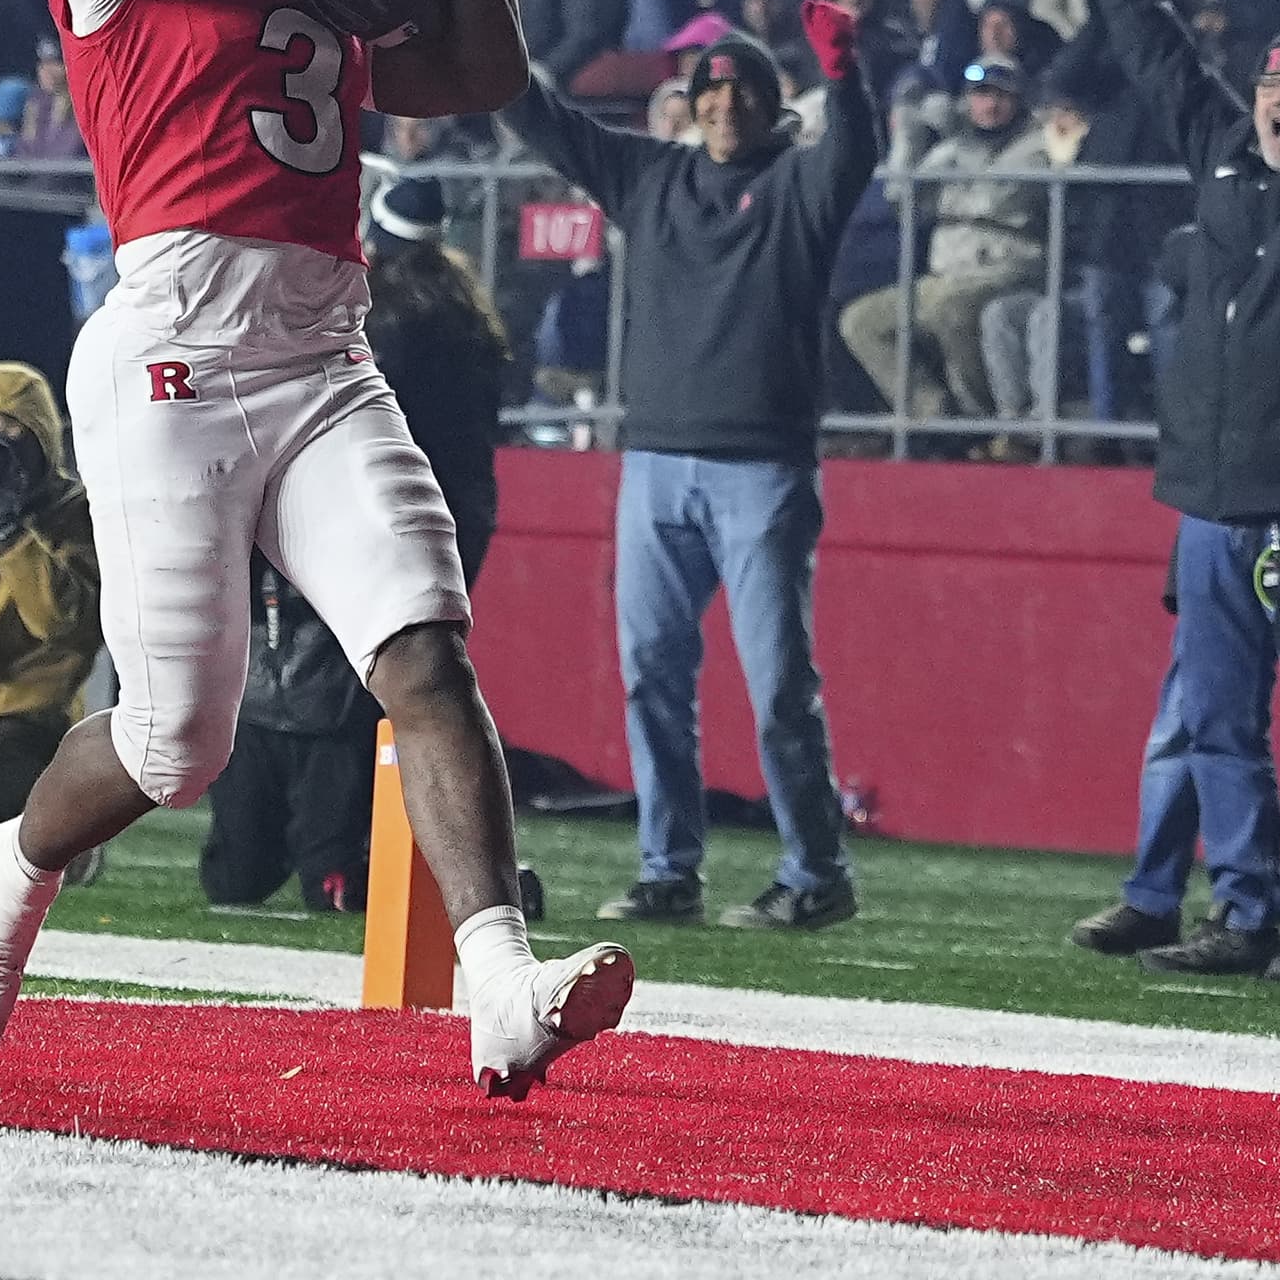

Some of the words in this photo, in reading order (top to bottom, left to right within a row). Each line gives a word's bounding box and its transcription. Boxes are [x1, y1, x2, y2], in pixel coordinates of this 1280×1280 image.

[251, 6, 344, 175] 3
[532, 210, 595, 254] 107
[145, 360, 197, 402] R
